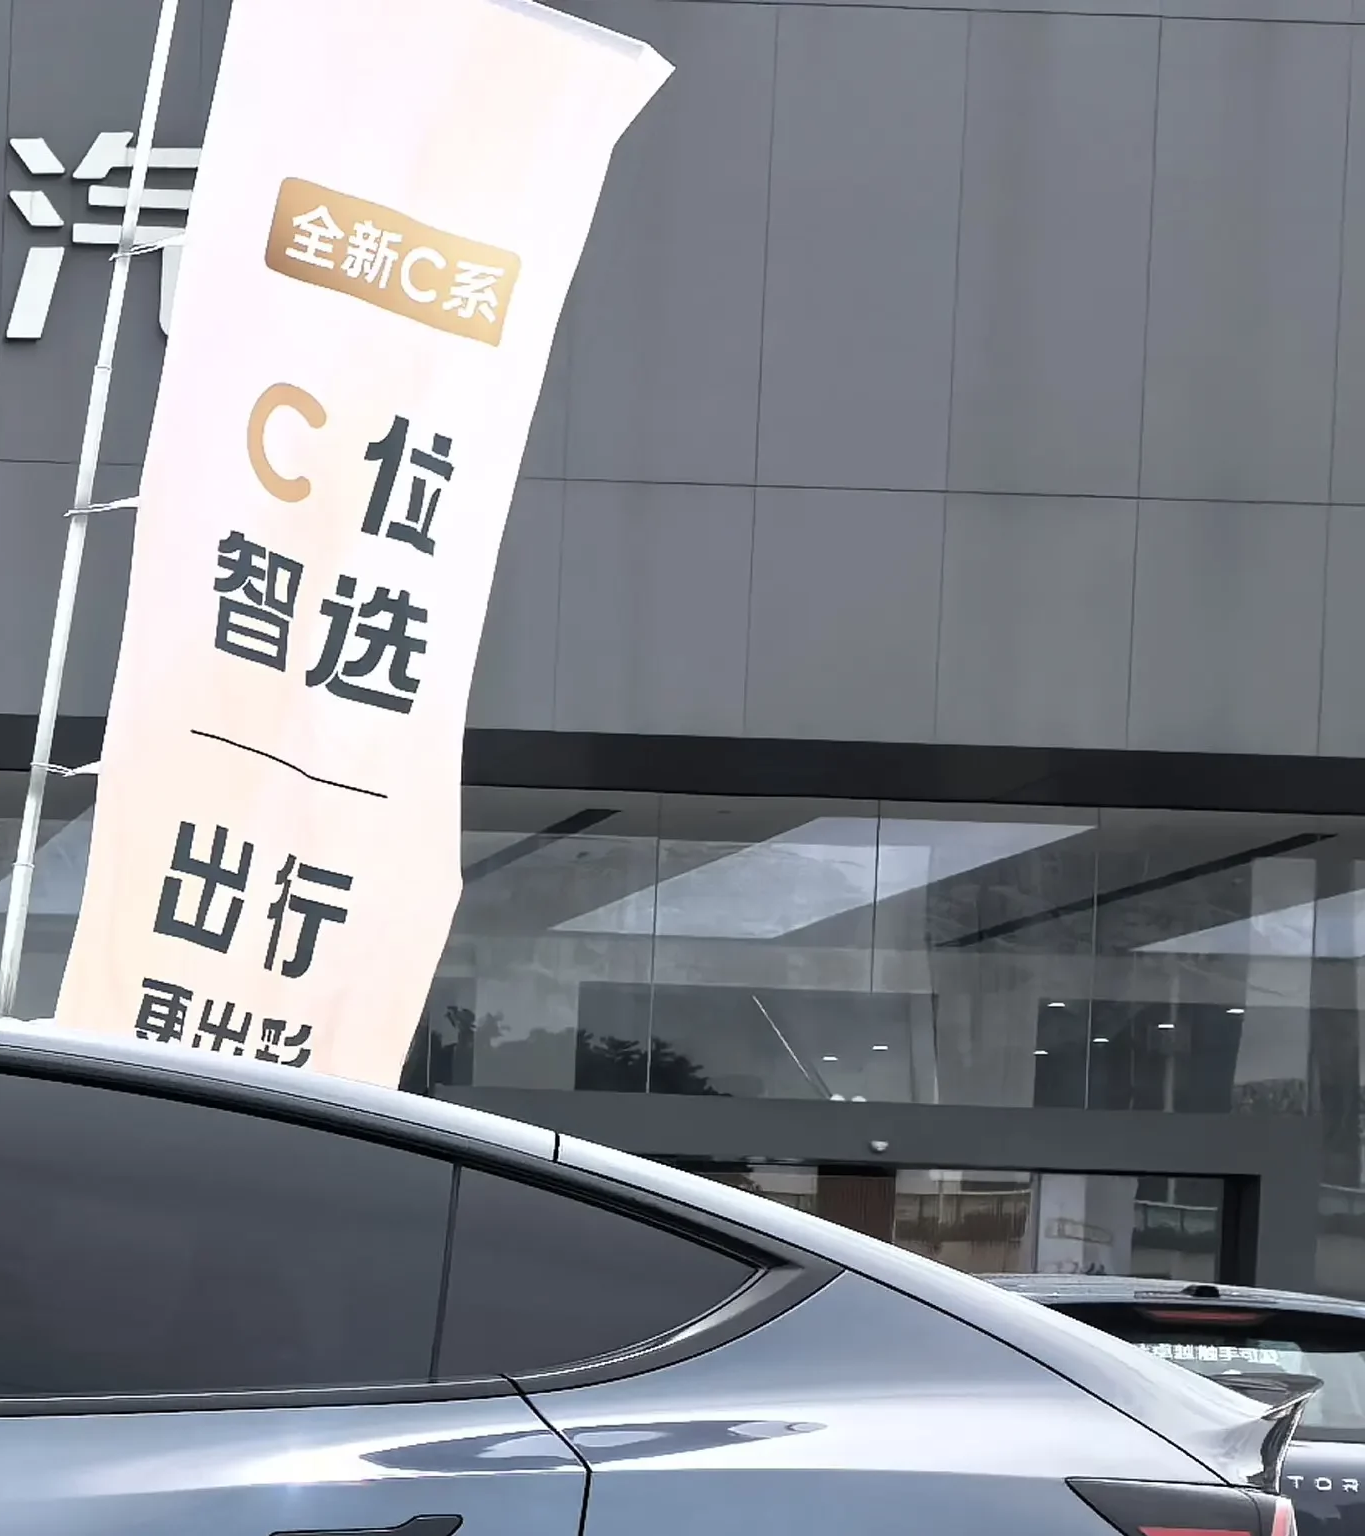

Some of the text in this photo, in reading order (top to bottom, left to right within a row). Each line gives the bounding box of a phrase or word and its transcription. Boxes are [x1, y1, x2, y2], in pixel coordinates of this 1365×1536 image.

[284, 204, 506, 325] 全新C系
[213, 529, 429, 715] 智选
[152, 820, 354, 979] 出行
[1286, 1475, 1359, 1493] TOR
